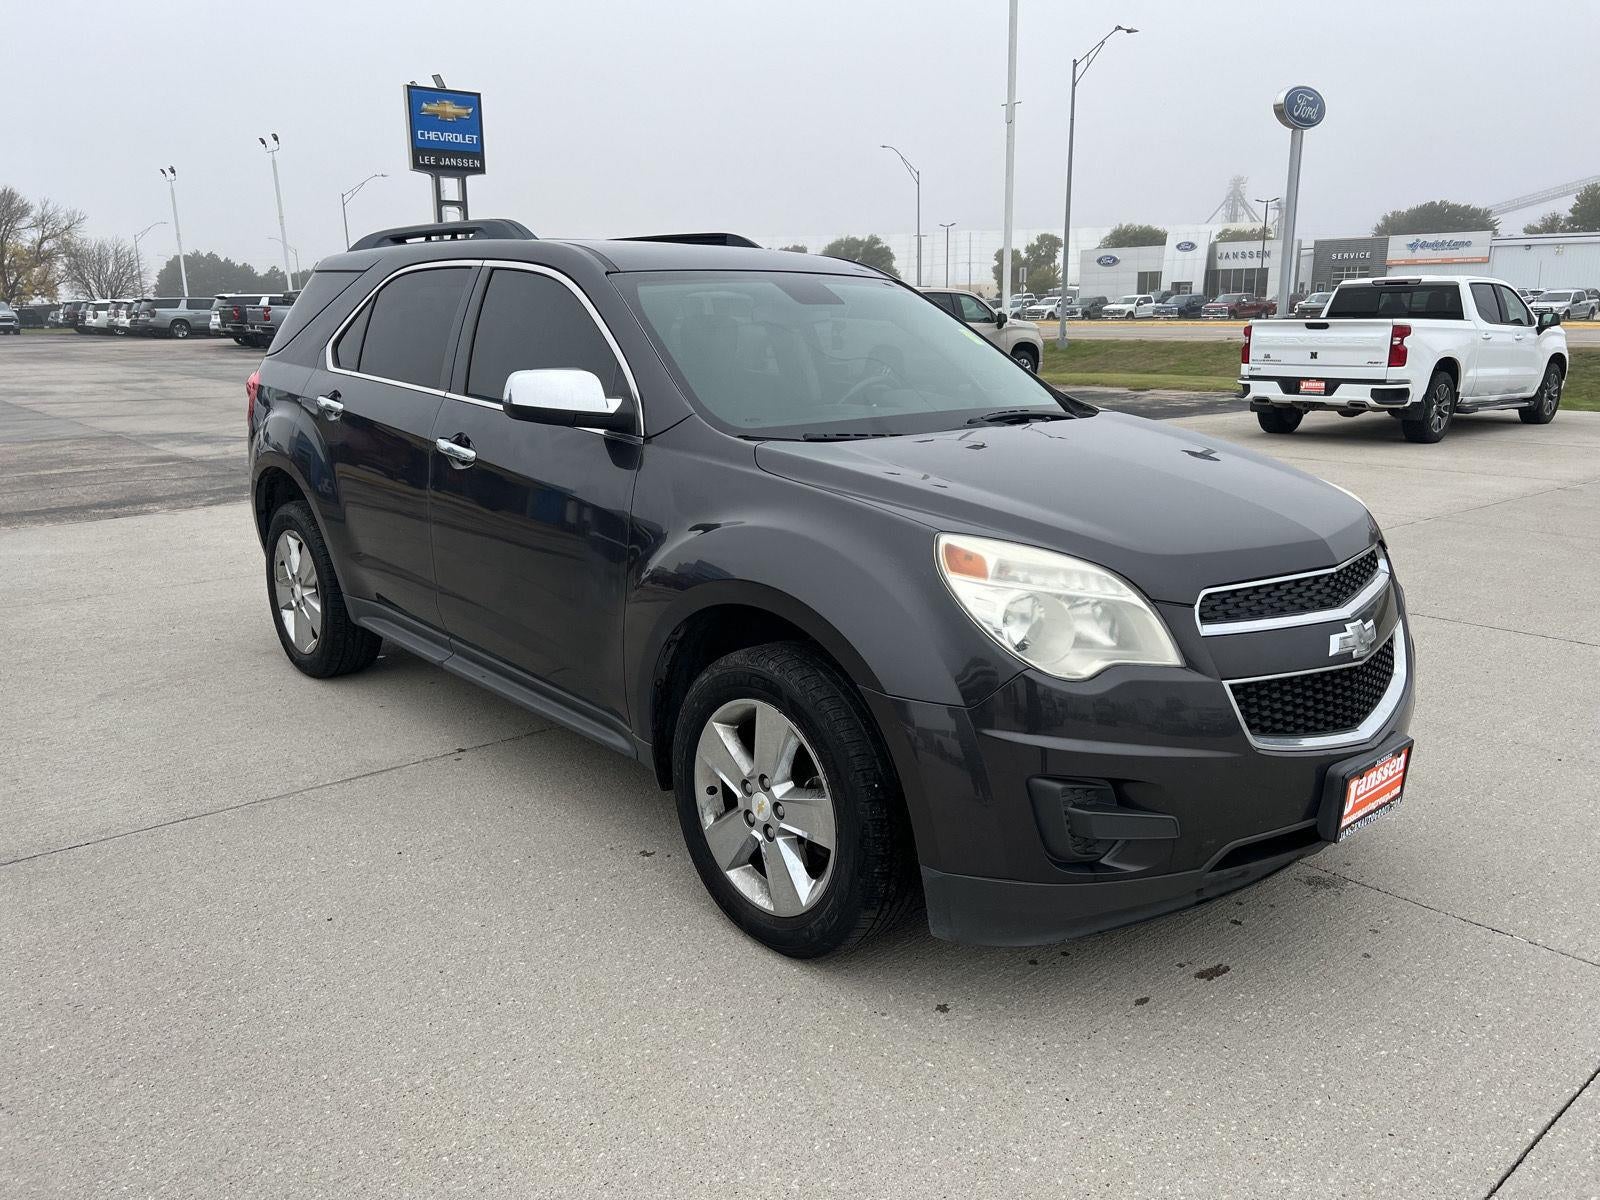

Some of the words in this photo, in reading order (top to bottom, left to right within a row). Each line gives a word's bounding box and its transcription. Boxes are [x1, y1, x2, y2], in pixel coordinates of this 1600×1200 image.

[1294, 93, 1319, 120] Ford
[418, 130, 478, 144] CHEVROLET
[419, 156, 436, 165] LEE
[440, 157, 480, 168] JANSSEN
[1218, 250, 1272, 260] JANSSEN
[1331, 251, 1372, 260] SERVICE
[1344, 753, 1406, 816] Janssen
